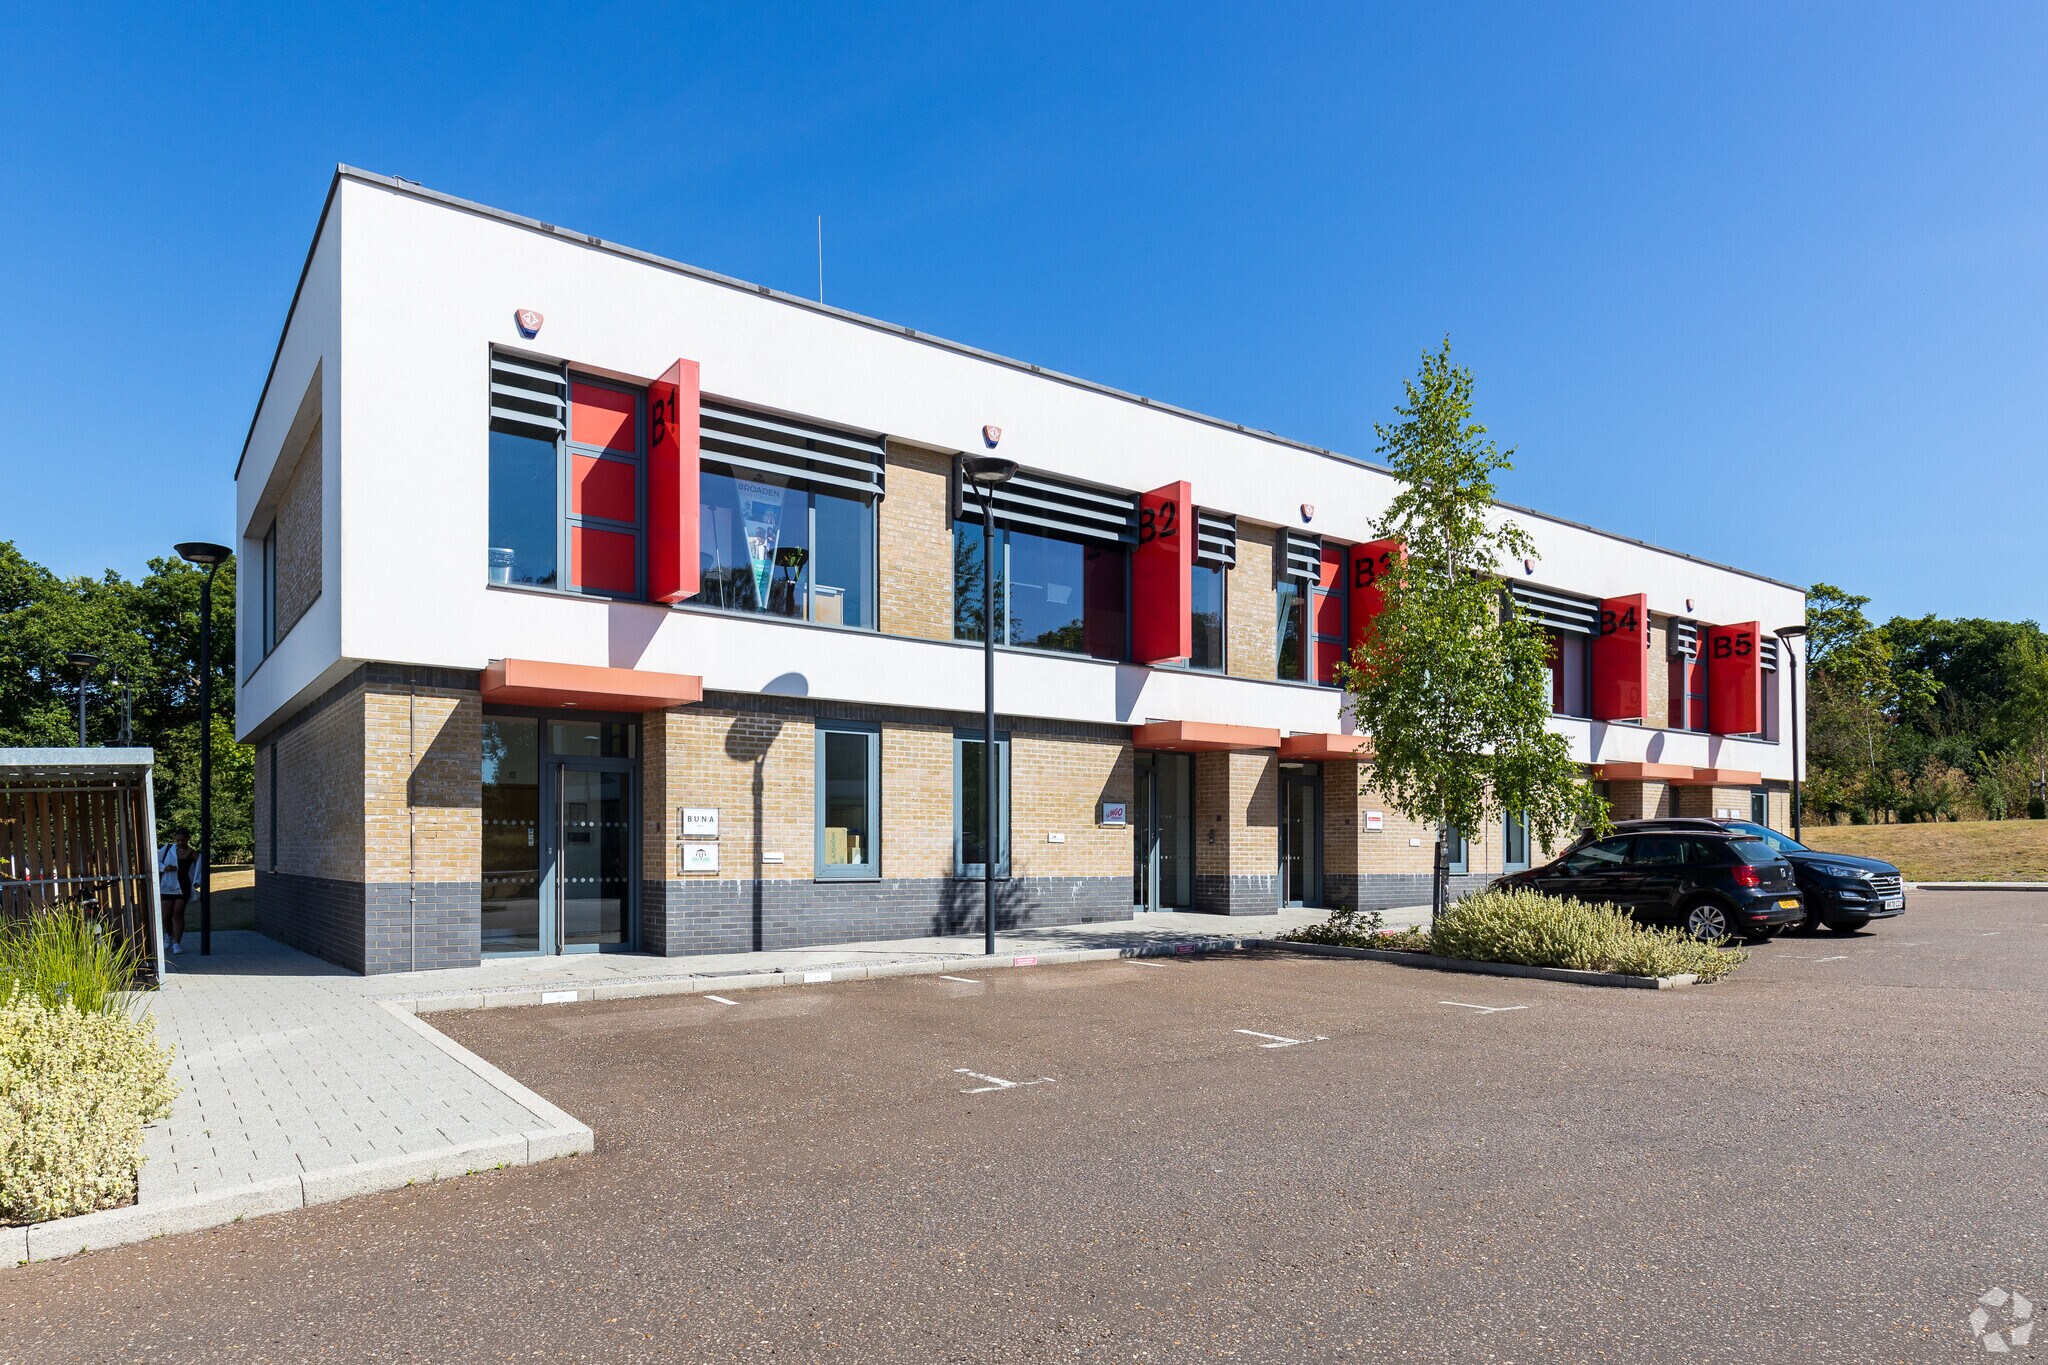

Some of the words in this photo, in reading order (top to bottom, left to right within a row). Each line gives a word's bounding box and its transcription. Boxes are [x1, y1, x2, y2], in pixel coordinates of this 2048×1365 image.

[651, 387, 675, 448] B1
[738, 483, 780, 498] BROADEN
[1139, 501, 1176, 544] B2
[1600, 606, 1638, 636] B4
[1713, 632, 1752, 659] B5
[687, 815, 715, 823] BUNA
